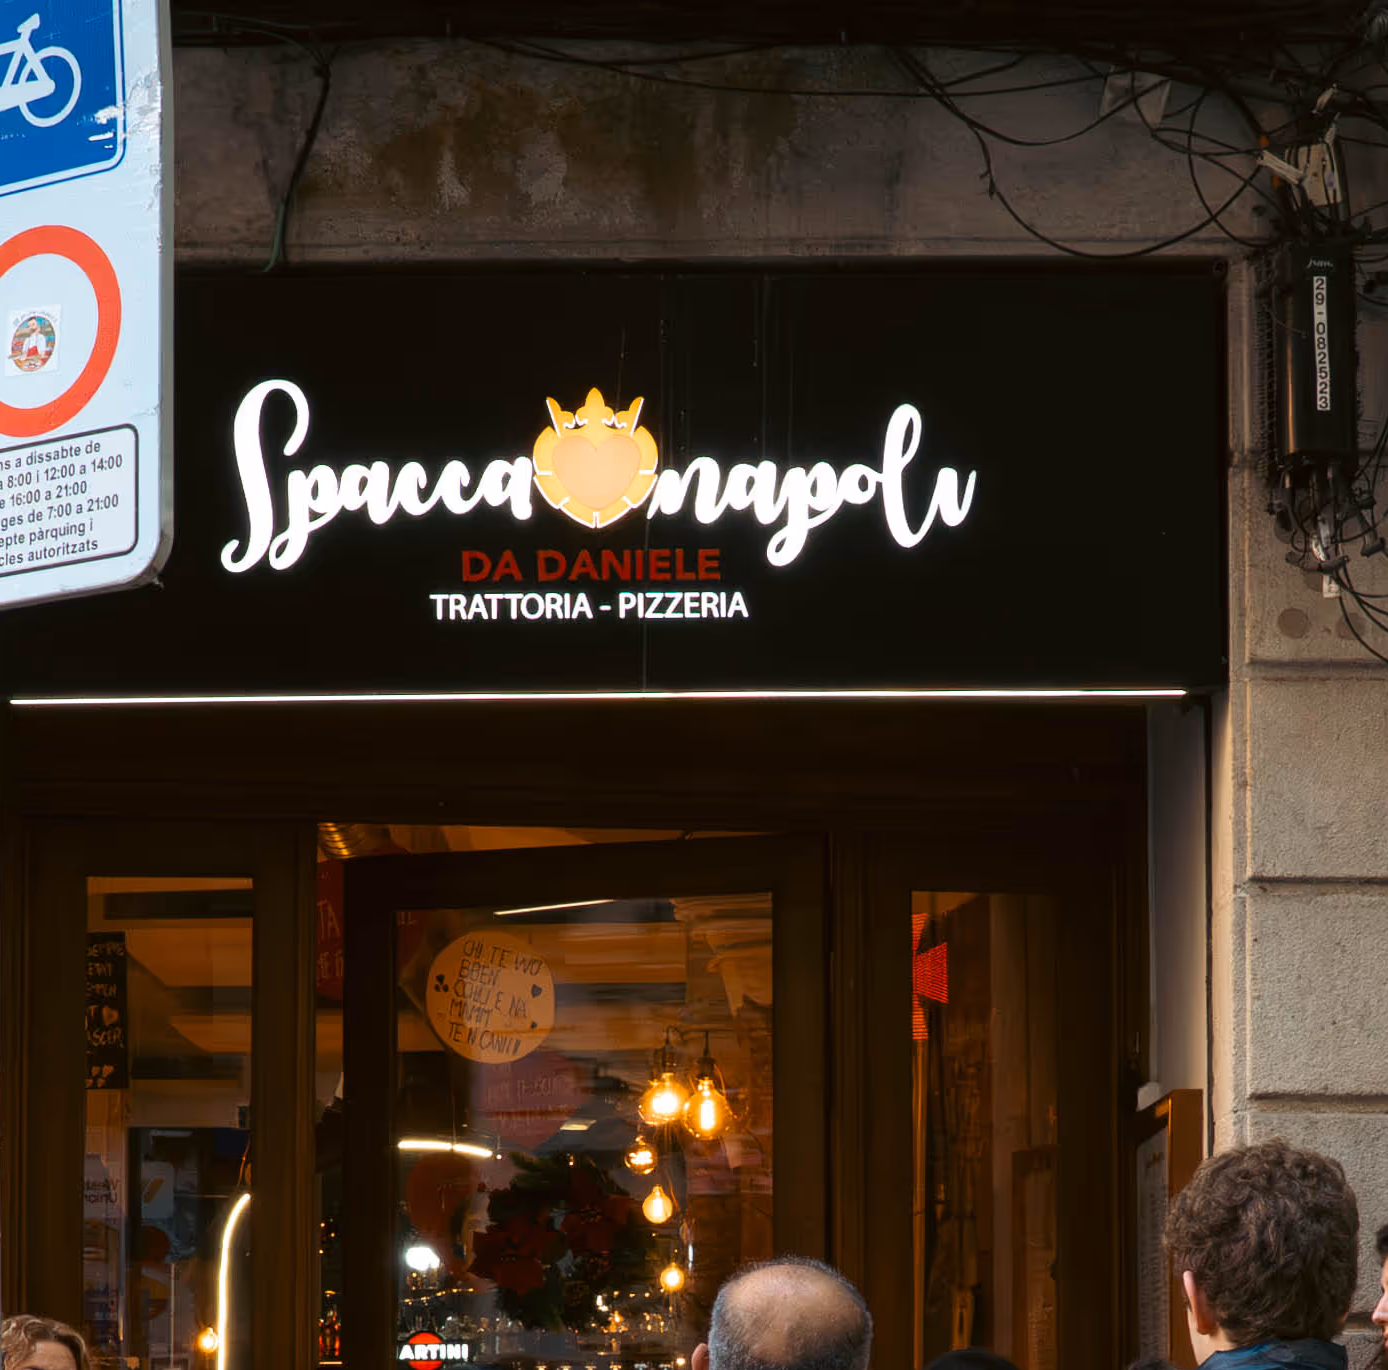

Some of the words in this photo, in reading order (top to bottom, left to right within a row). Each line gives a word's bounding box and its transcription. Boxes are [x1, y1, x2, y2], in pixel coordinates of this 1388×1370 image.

[15, 457, 22, 468] a
[25, 445, 81, 467] dissabte
[85, 440, 101, 455] de
[7, 471, 32, 489] 8:00
[36, 470, 40, 484] i
[44, 463, 76, 482] 12:00
[79, 464, 86, 475] a
[91, 454, 123, 473] 14:00
[221, 378, 535, 572] Spacca
[10, 489, 41, 507] 16:00
[45, 490, 52, 501] a
[55, 480, 87, 499] 21:00
[28, 510, 43, 524] de
[46, 502, 72, 520] 7:00
[76, 503, 83, 515] a
[87, 494, 119, 513] 21:00
[29, 522, 85, 545] pàrquing
[90, 518, 94, 532] i
[27, 539, 99, 562] autoritzats
[461, 550, 524, 583] DA
[537, 548, 720, 582] DANIELE
[430, 593, 593, 620] TRATTORIA
[619, 592, 749, 619] PIZZERIA
[396, 1343, 469, 1362] ARTINI
